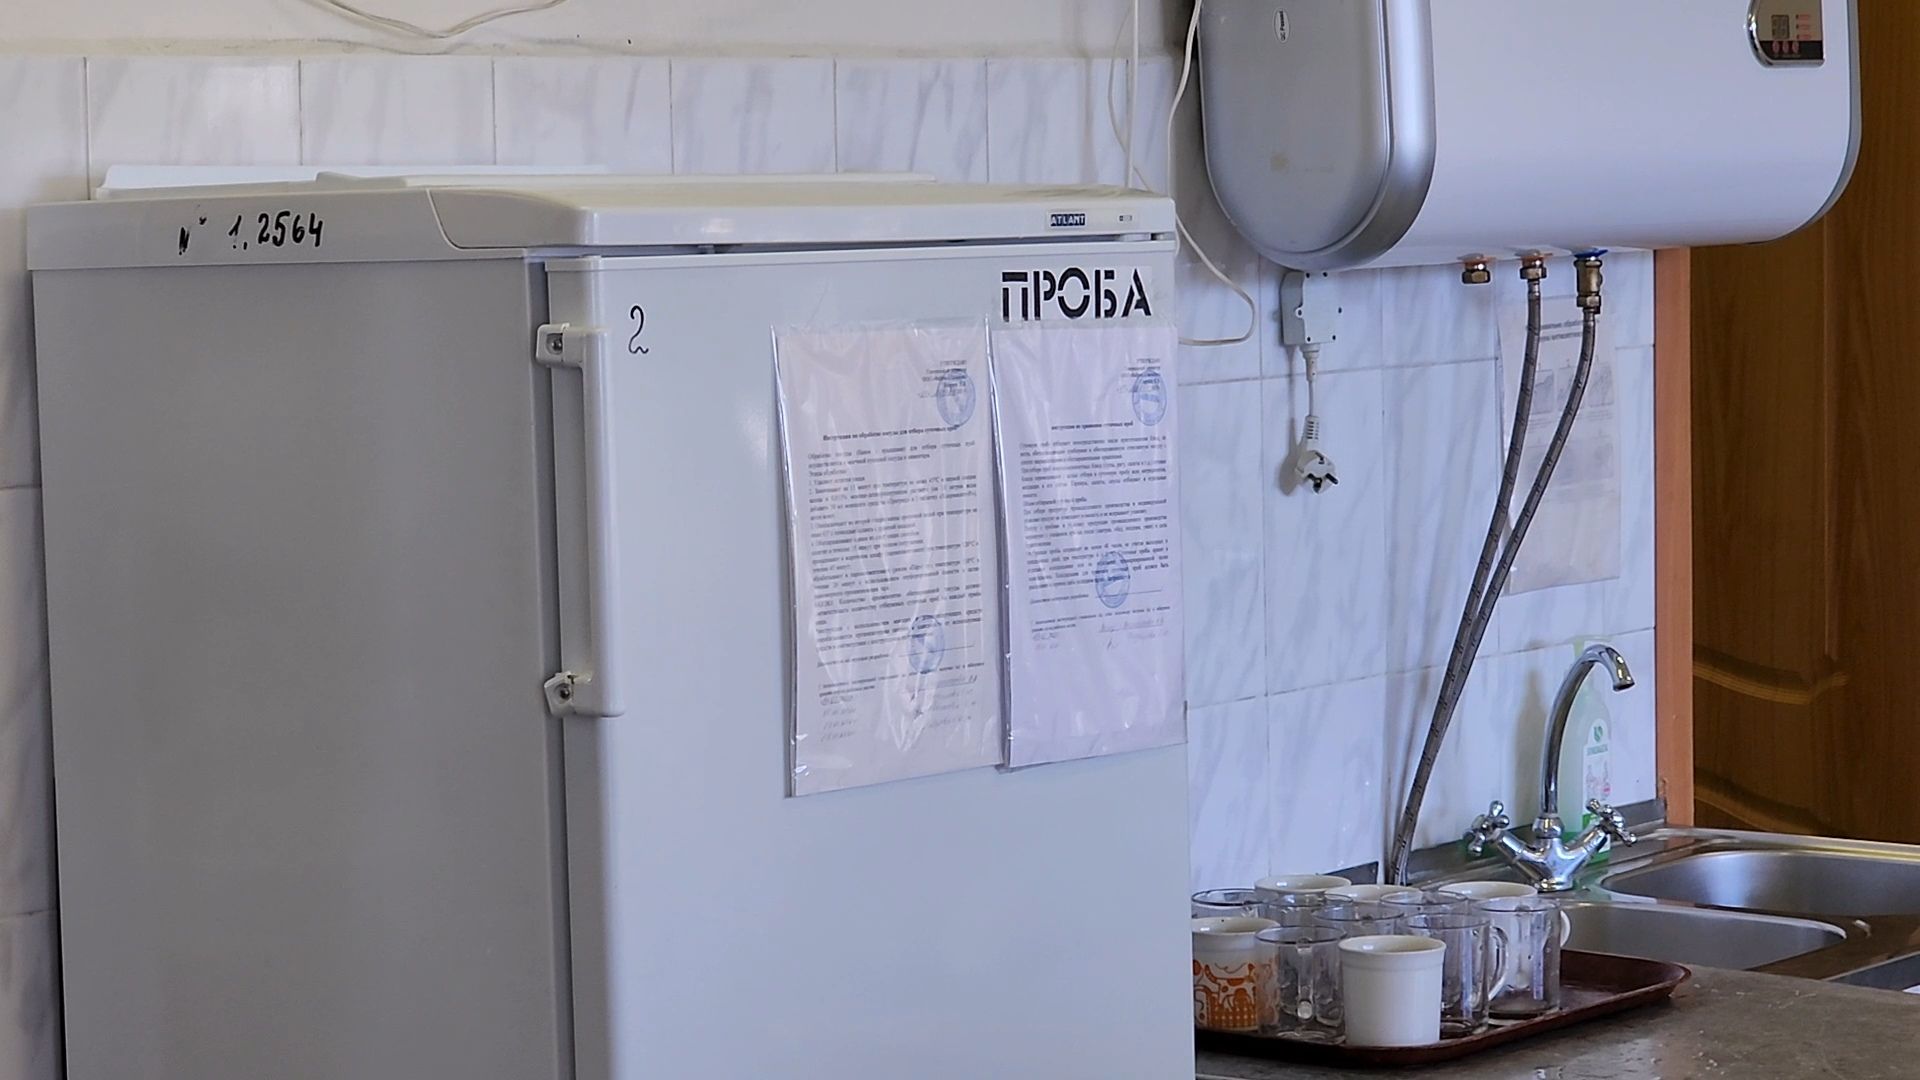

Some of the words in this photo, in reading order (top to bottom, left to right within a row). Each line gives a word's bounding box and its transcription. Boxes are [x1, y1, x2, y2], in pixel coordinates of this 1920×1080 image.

[258, 211, 323, 247] 2564
[1051, 214, 1085, 226] ATLANT
[1002, 267, 1152, 322] ПРОБА
[628, 305, 649, 354] 2
